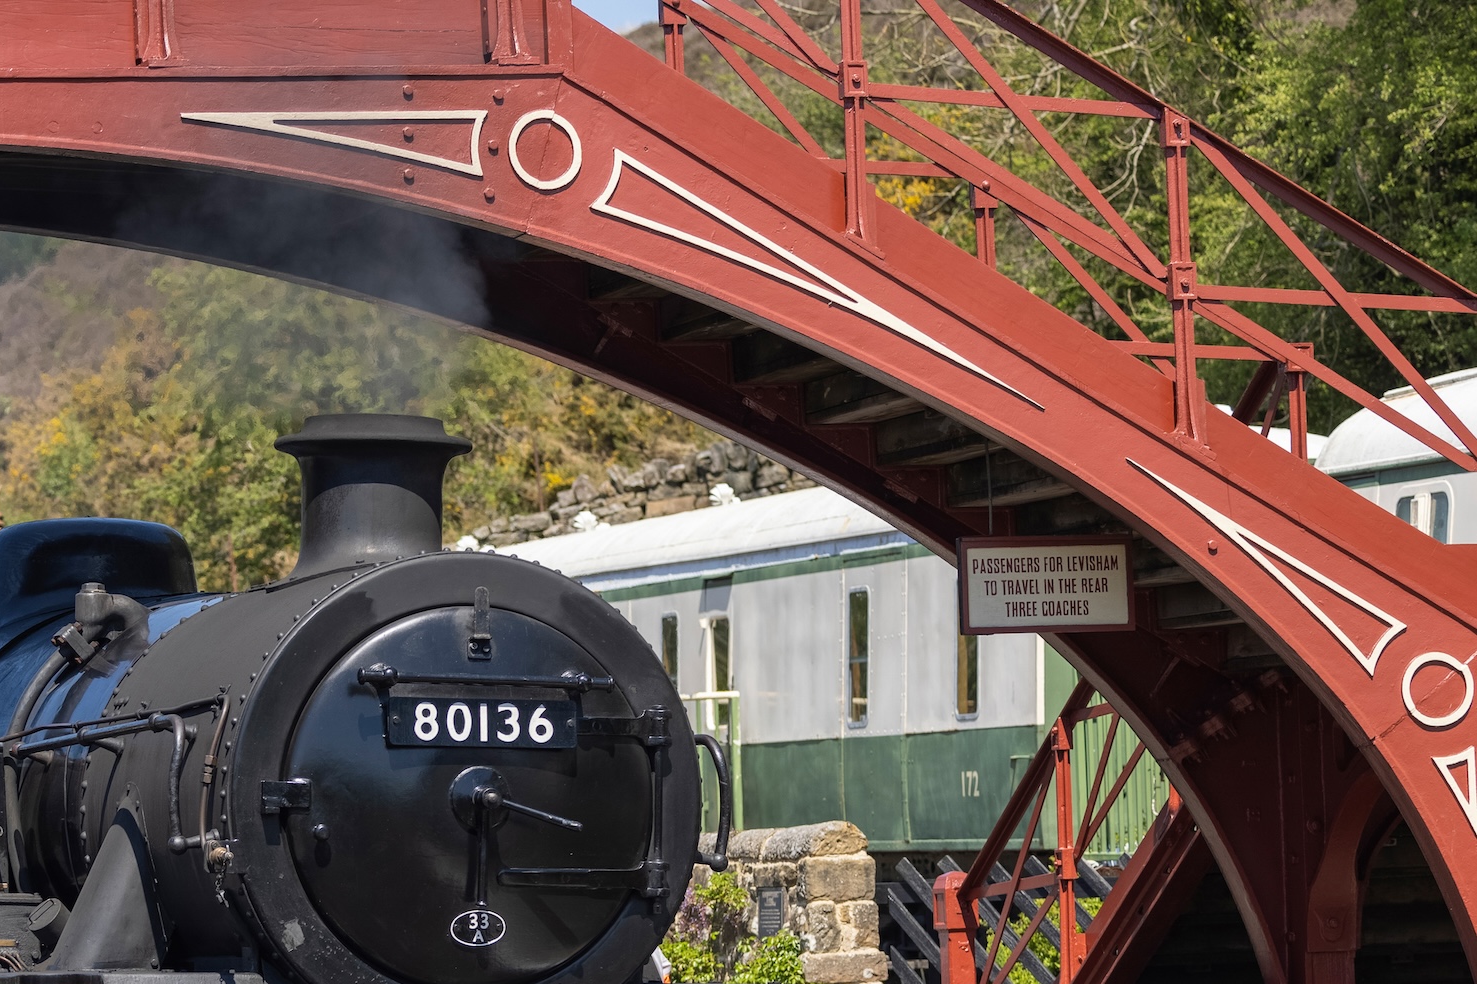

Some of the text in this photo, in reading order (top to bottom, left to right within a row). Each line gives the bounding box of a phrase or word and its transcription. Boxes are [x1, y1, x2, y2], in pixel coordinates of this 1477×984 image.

[972, 555, 1119, 574] PASSENGERS FOR LEVISHAM
[984, 577, 1109, 596] TO TRAVEL IN THE REAR
[1005, 600, 1089, 618] THREE COACHES
[413, 701, 554, 744] 80136
[961, 770, 980, 797] 172
[468, 912, 490, 930] 33
[472, 928, 484, 943] A
